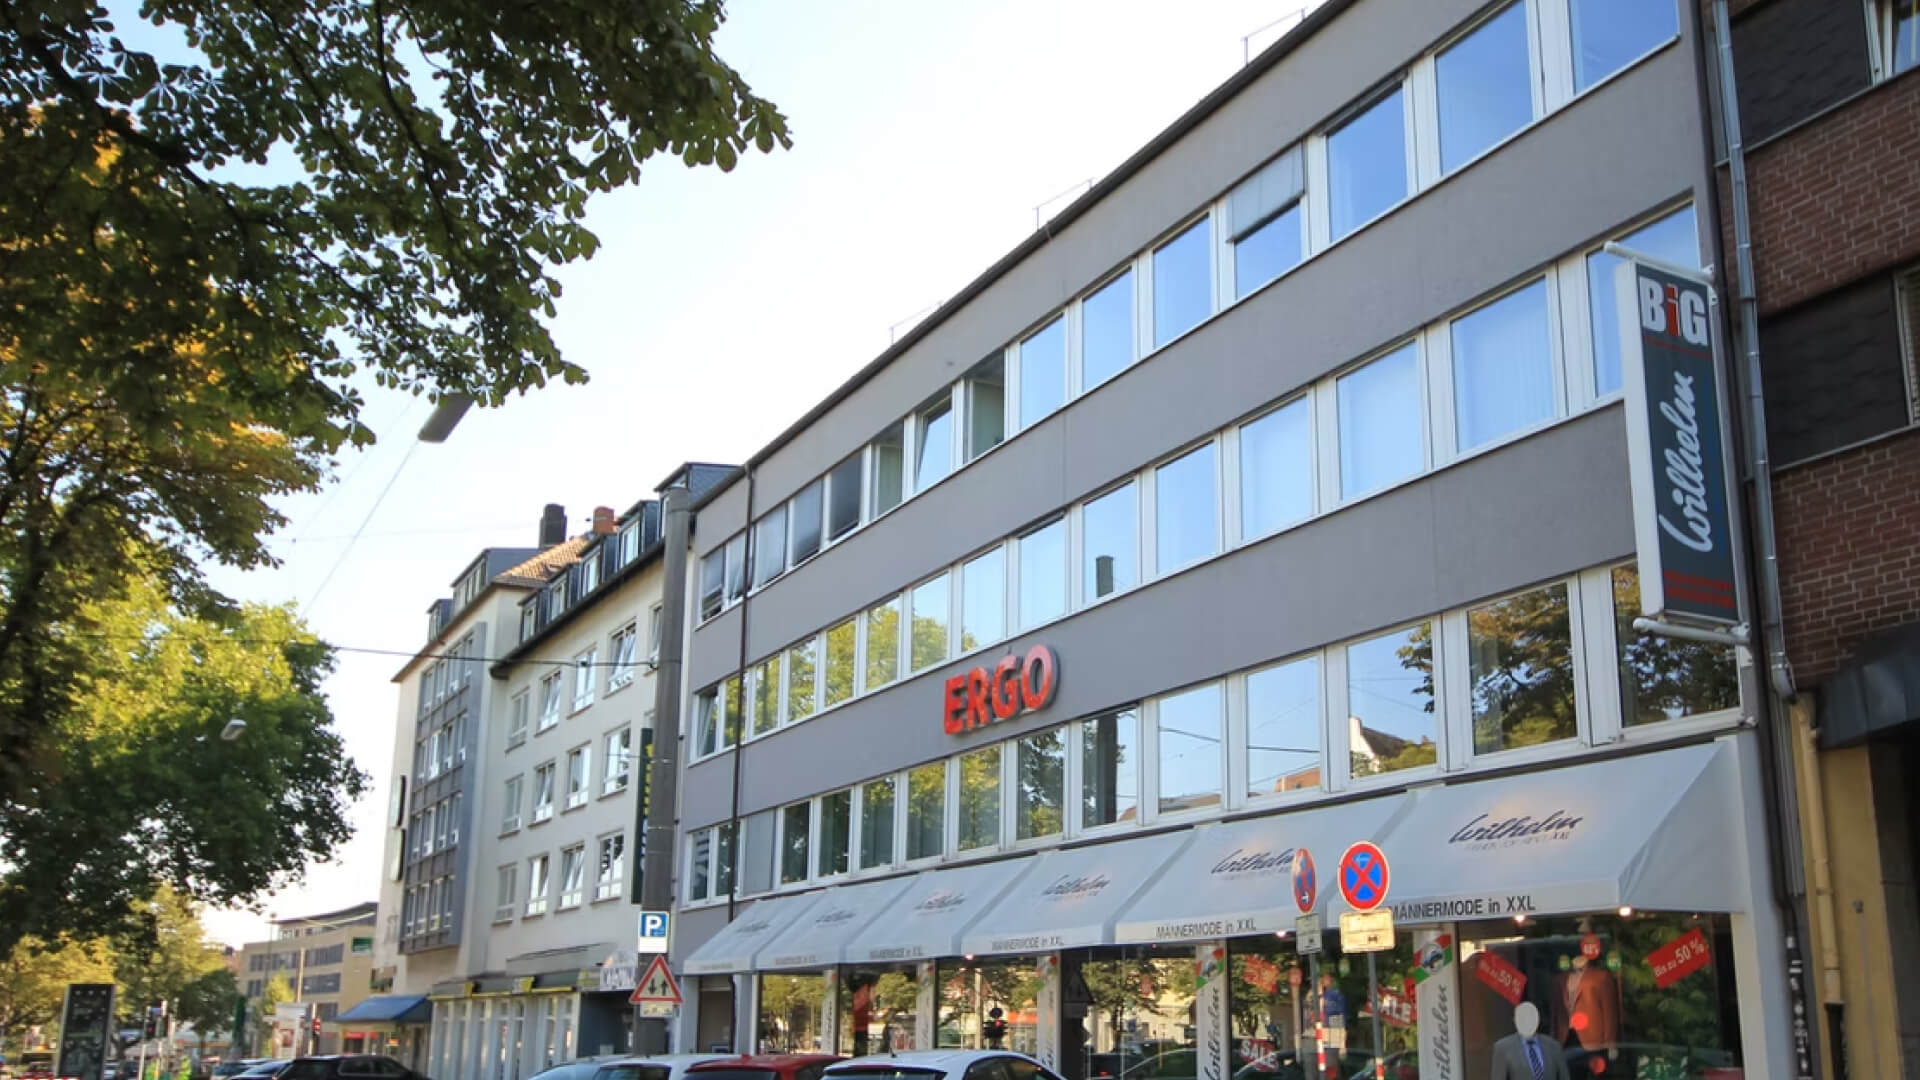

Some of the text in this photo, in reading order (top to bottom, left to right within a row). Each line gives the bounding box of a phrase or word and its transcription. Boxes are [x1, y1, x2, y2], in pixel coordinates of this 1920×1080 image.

[944, 644, 1060, 736] ERGO
[1488, 898, 1501, 914] in
[1506, 895, 1536, 912] XXL
[645, 914, 663, 936] P
[1237, 917, 1257, 932] XXL
[1241, 1039, 1278, 1069] SALE
